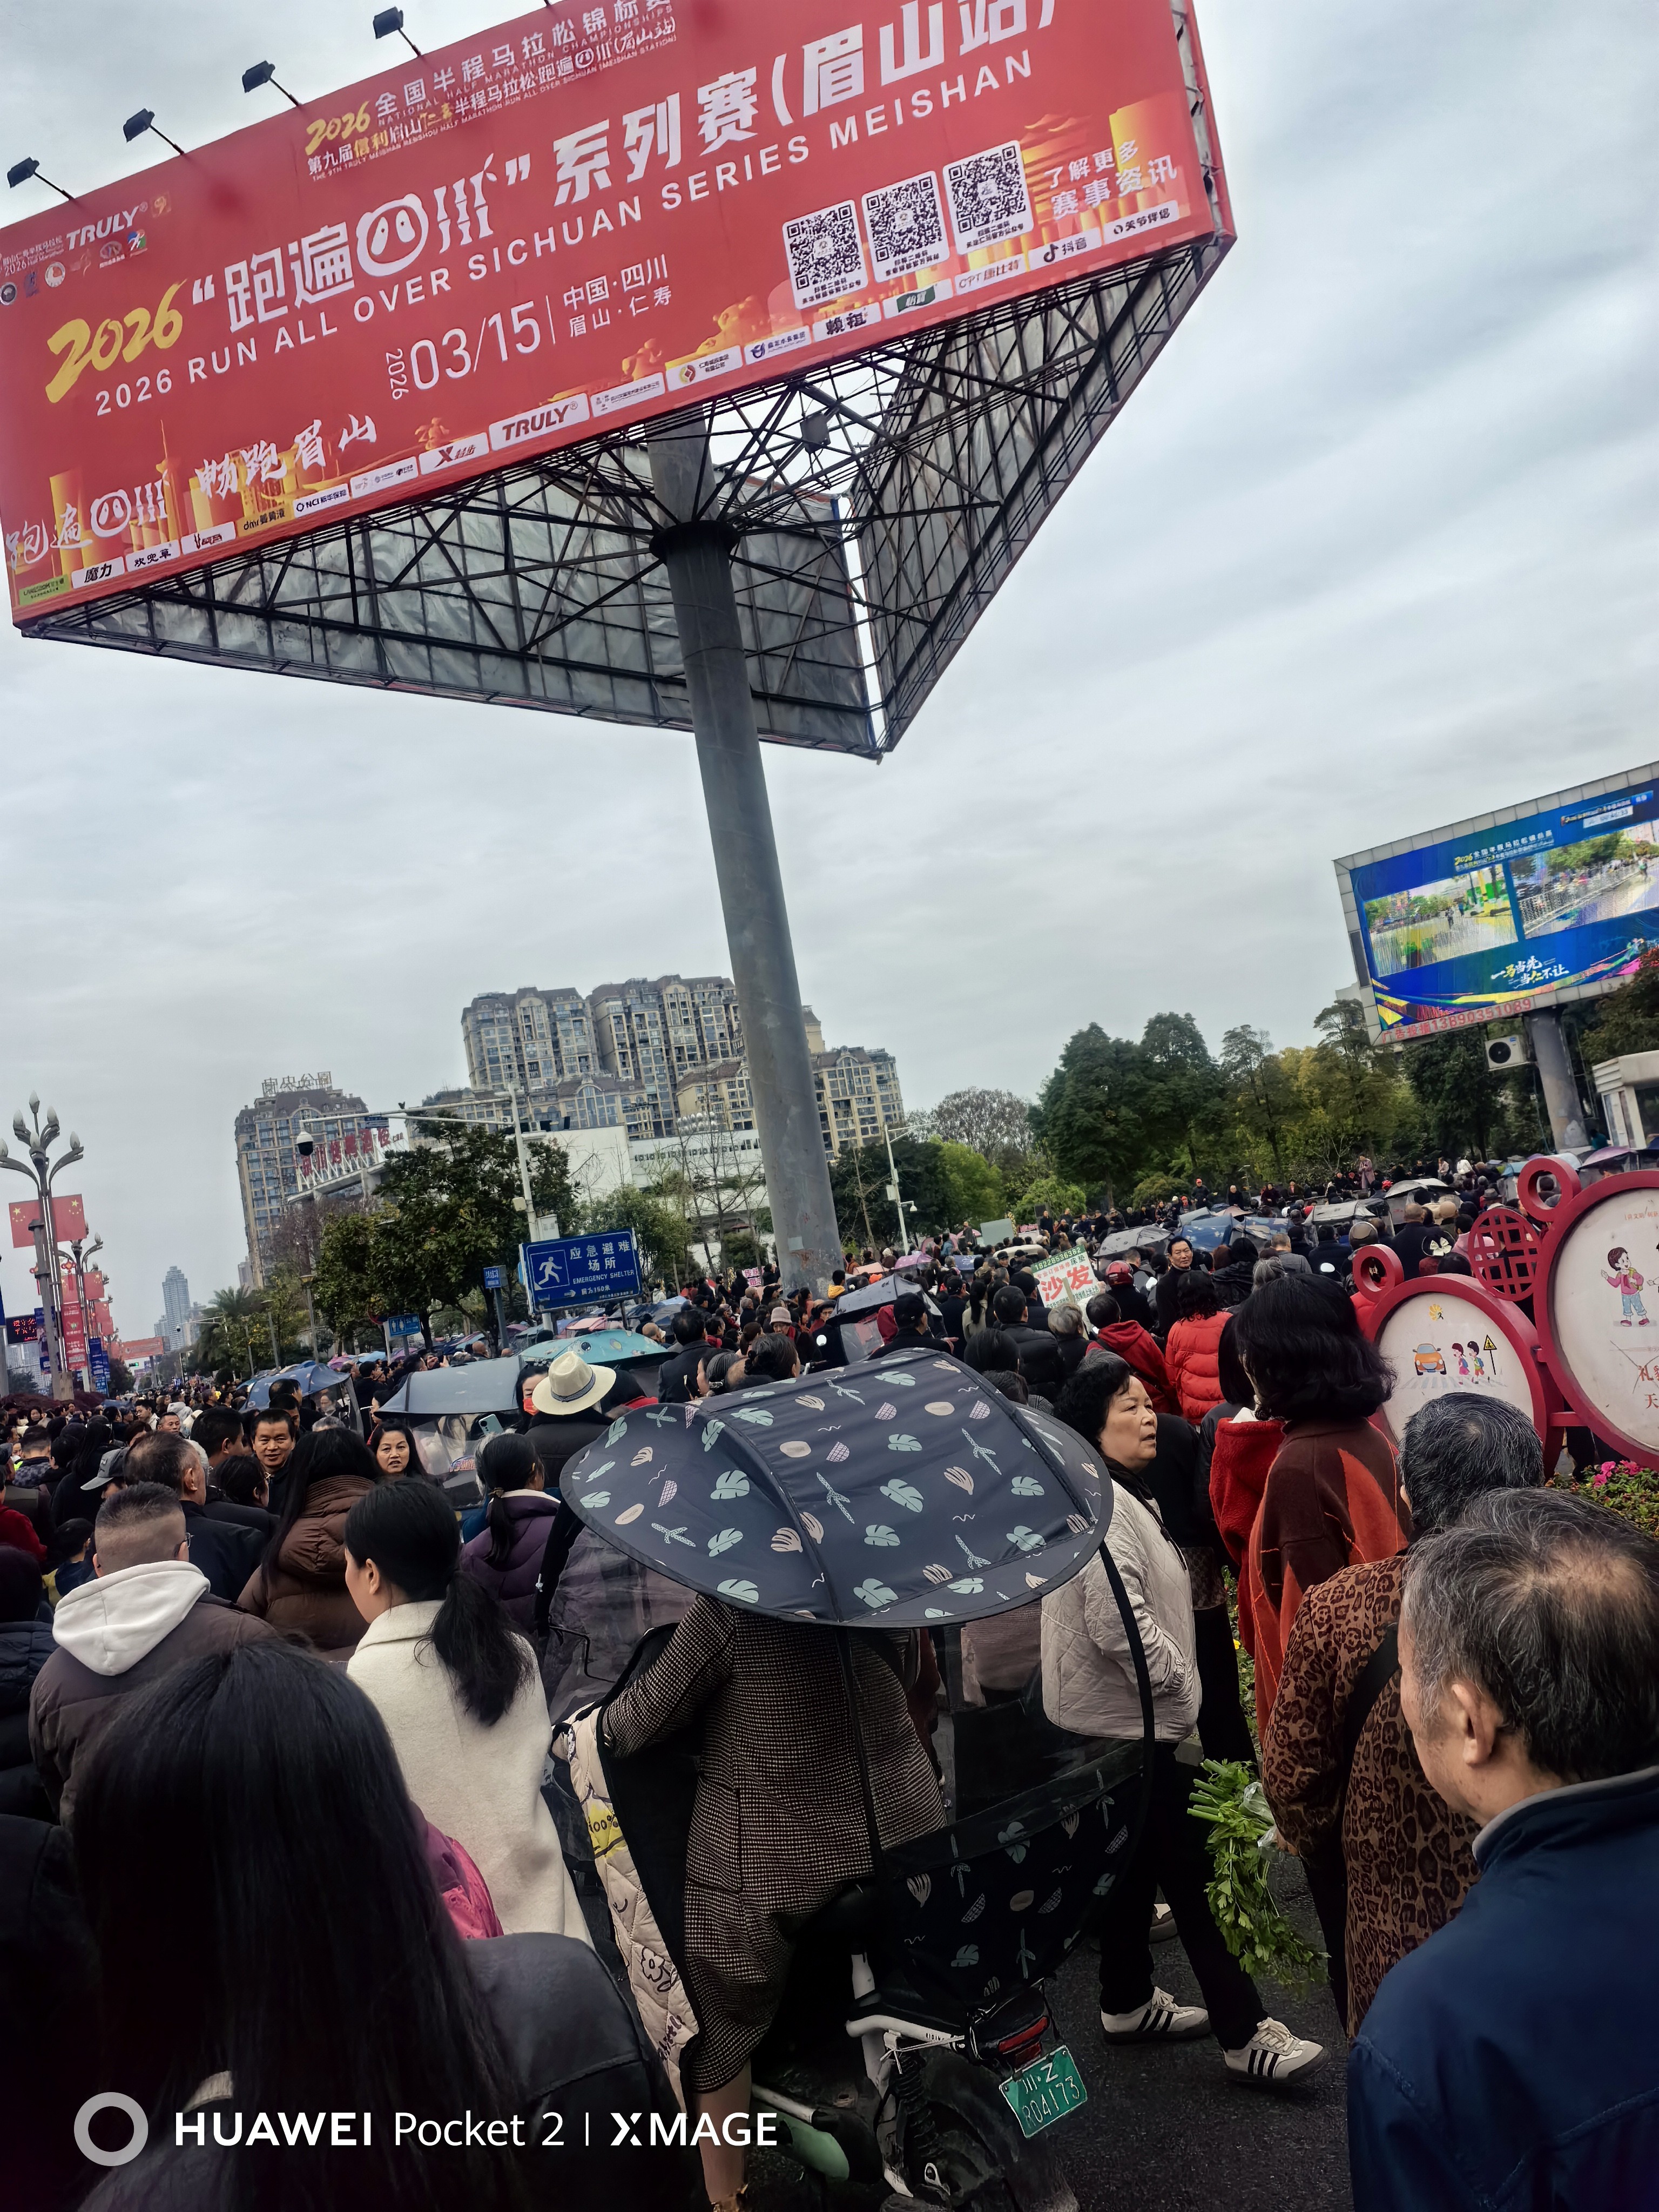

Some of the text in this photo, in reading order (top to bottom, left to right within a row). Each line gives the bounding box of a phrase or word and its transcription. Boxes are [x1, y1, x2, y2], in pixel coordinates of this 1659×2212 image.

[305, 0, 671, 156] 2026 全国半程马拉松锦标
[1043, 139, 1139, 190] 了解更多
[1050, 154, 1177, 221] 赛事资讯
[66, 205, 139, 251] TRULY
[96, 49, 1033, 416] 2026 RUN ALL OVER SICHUAN SERIES MEISHAN
[1062, 236, 1088, 256] 抖音
[45, 277, 188, 405] 2026
[385, 300, 542, 400] 2026 03/15
[502, 403, 570, 441] TRULY
[194, 413, 377, 500] 畅跑眉山
[1491, 955, 1543, 980] 一马当先
[570, 1239, 631, 1260] 应急避难
[588, 1256, 616, 1272] 场所
[573, 1270, 635, 1284] EMERGENCY SHELTER
[1040, 1264, 1094, 1302] 沙发
[1644, 1393, 1659, 1409] 天
